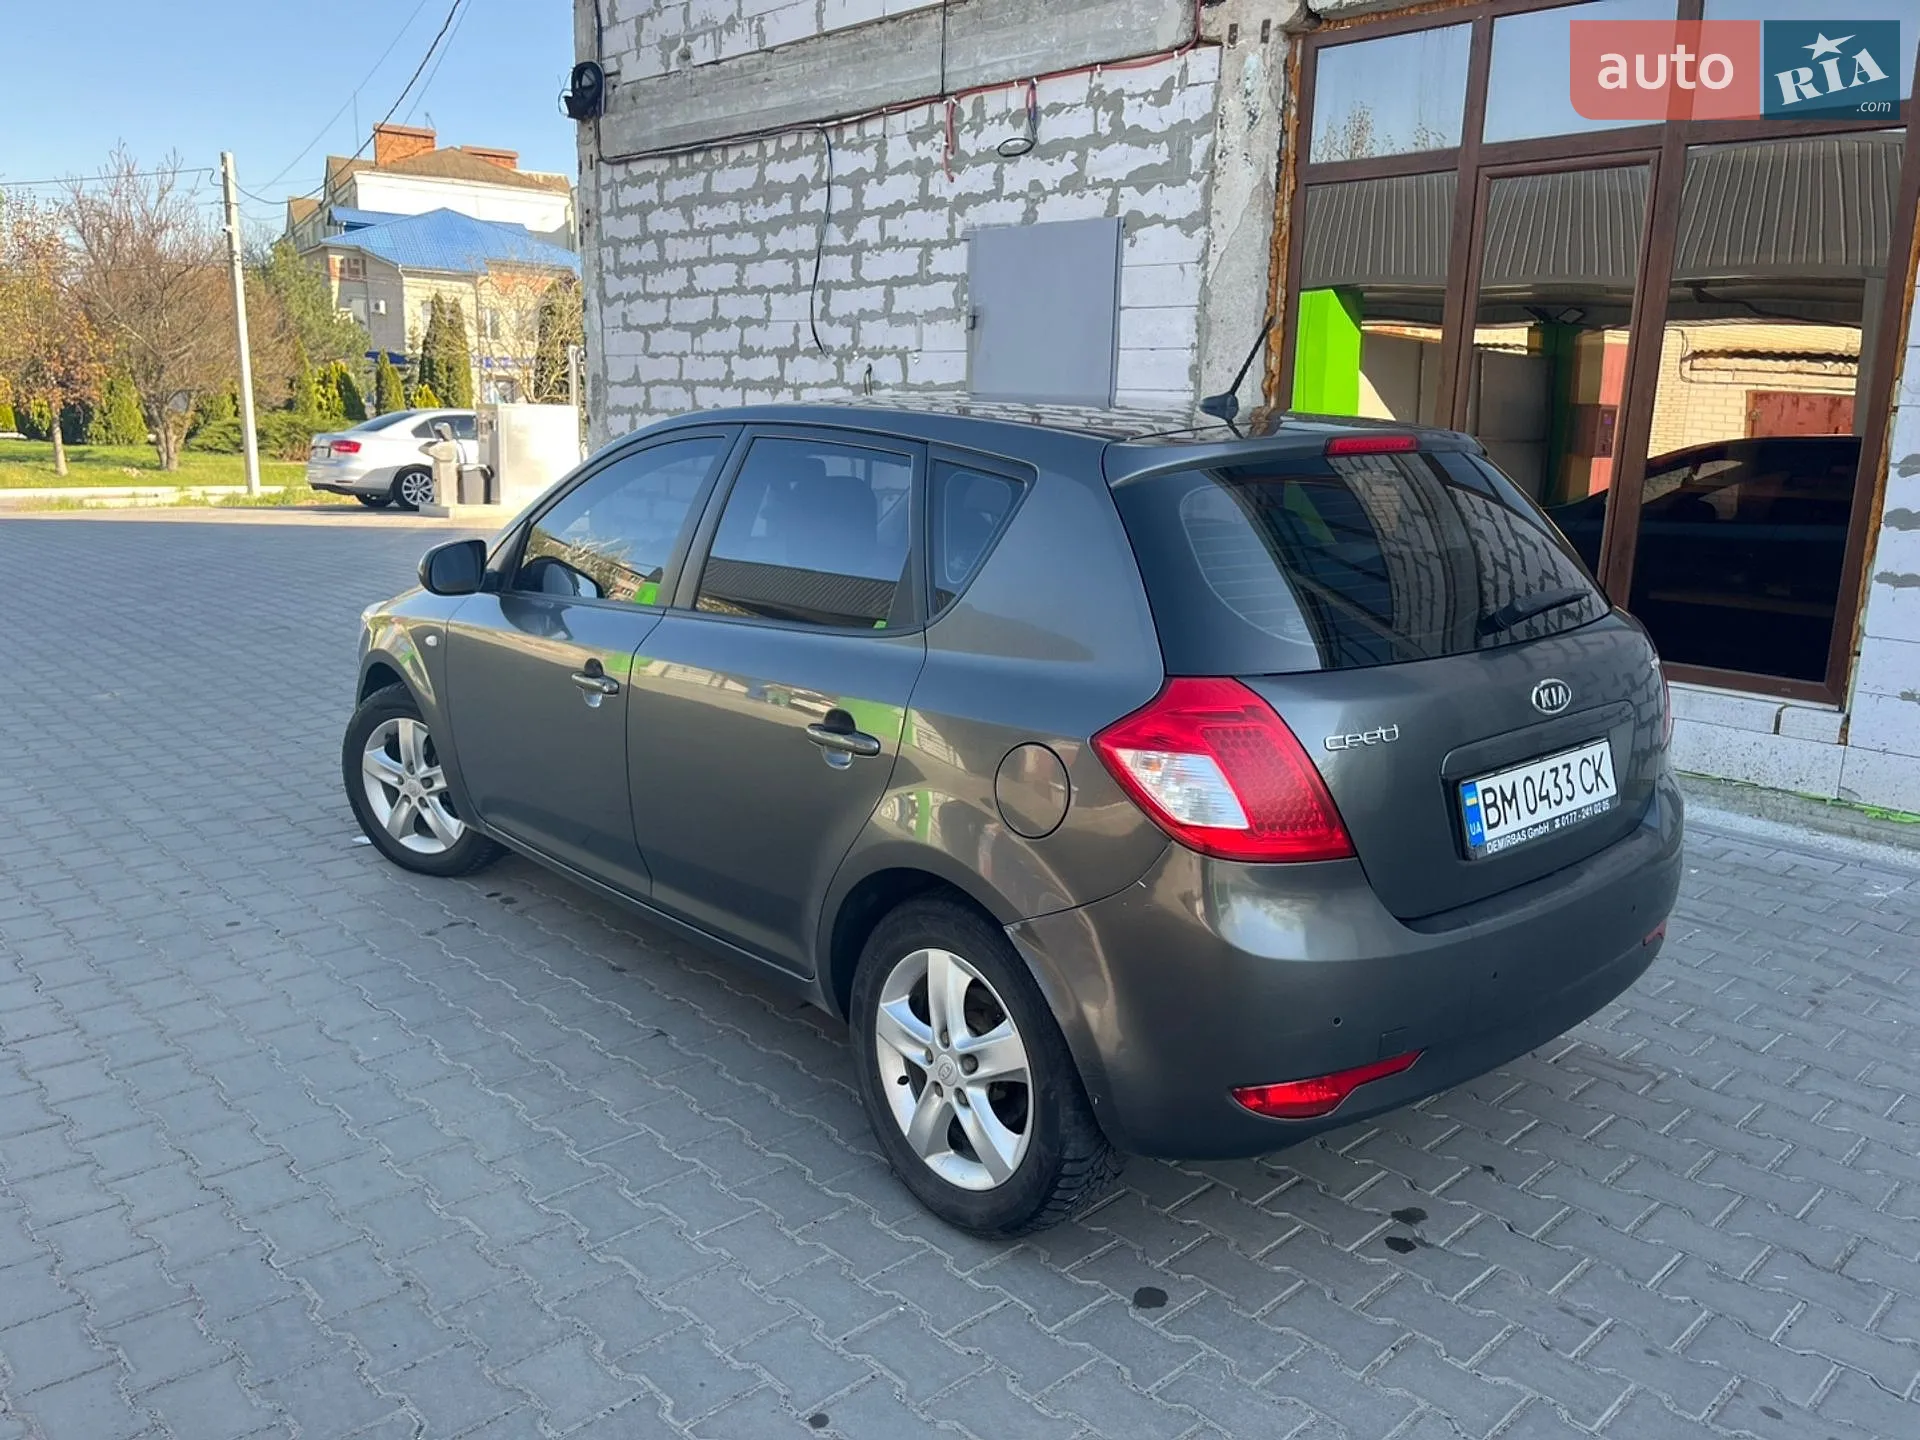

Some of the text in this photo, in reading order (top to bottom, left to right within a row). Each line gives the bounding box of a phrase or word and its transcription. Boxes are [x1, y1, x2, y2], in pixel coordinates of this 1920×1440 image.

[1539, 685, 1567, 708] KIA
[1481, 751, 1609, 830] BM 0433 CK
[1469, 821, 1483, 836] UA
[1486, 829, 1527, 854] DEMIRBAS
[1527, 821, 1550, 839] GmbH
